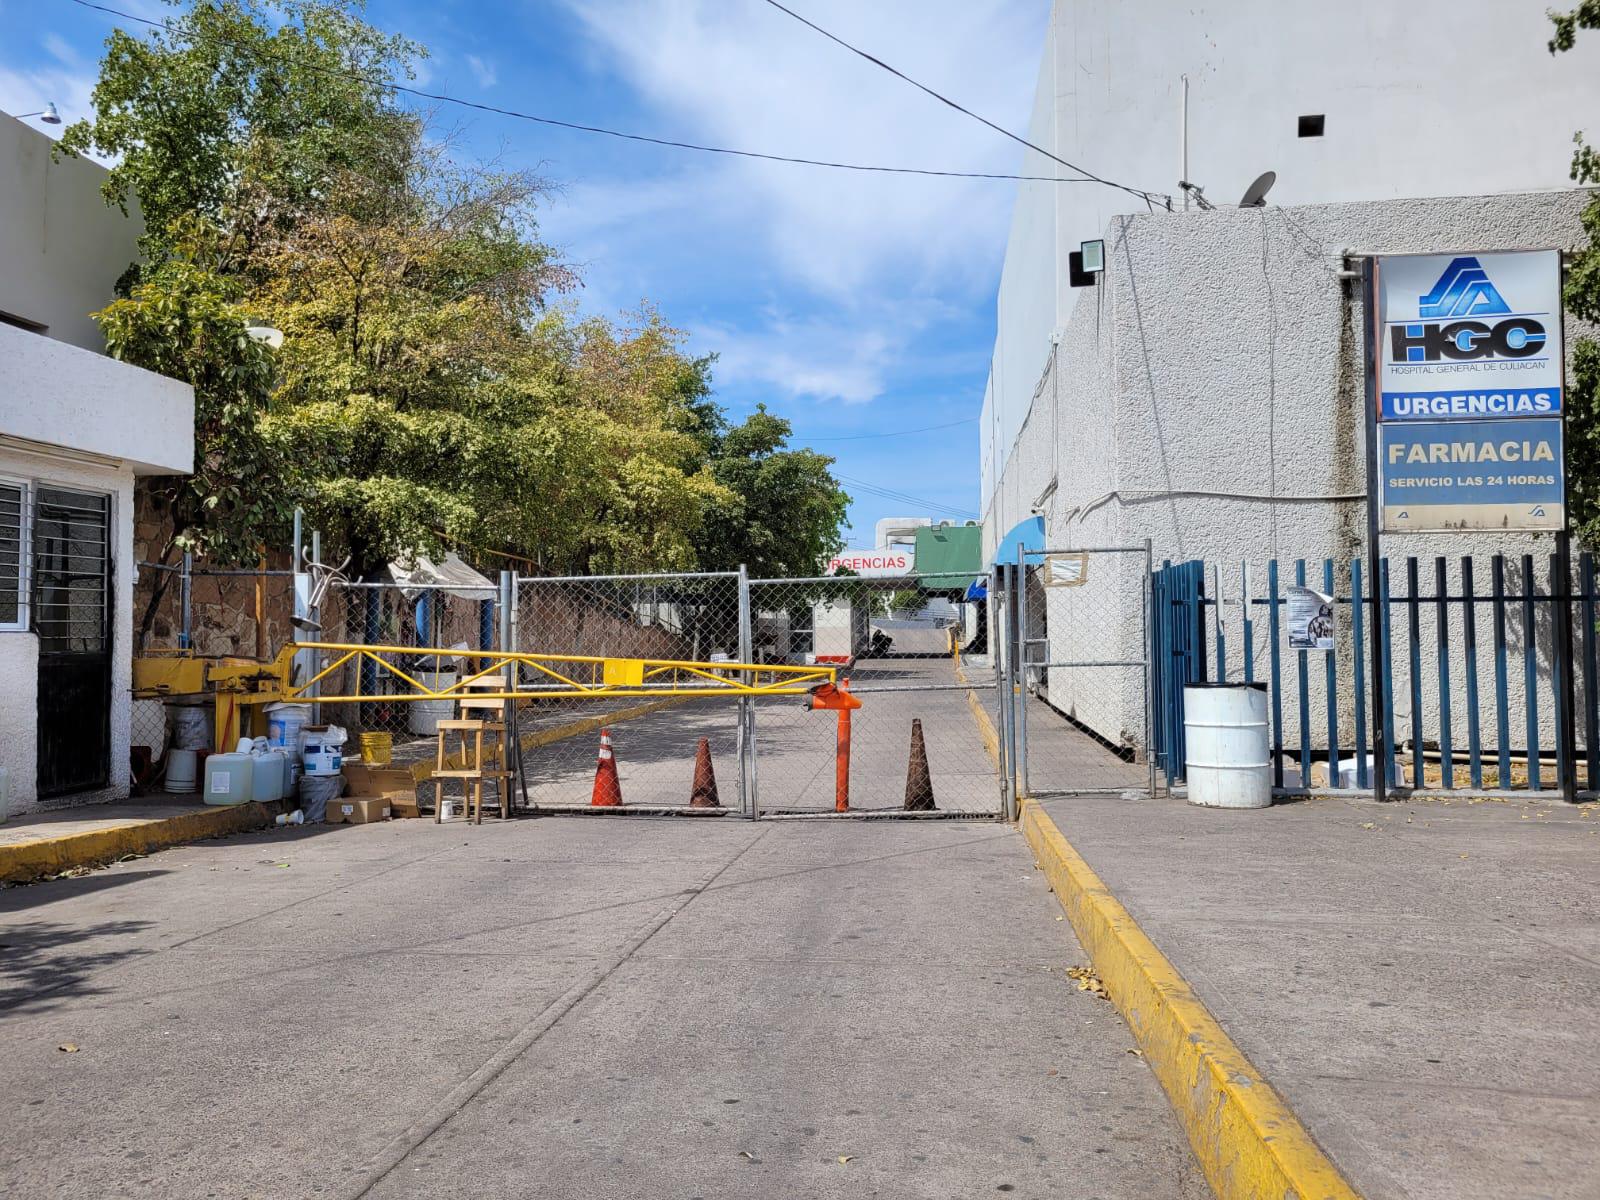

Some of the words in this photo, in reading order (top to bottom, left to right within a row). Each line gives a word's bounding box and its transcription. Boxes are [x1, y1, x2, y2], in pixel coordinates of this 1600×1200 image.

[1390, 317, 1547, 363] HGC
[1391, 366, 1434, 375] HOSPITAL
[1436, 364, 1481, 374] GENERAL
[1483, 362, 1497, 371] DE
[1392, 392, 1552, 416] URGENCIAS
[1388, 440, 1555, 465] FARMACIA
[1389, 477, 1453, 488] SERVICIO
[1457, 476, 1483, 487] LAS
[1487, 475, 1504, 486] 24
[1507, 475, 1555, 486] HORAS
